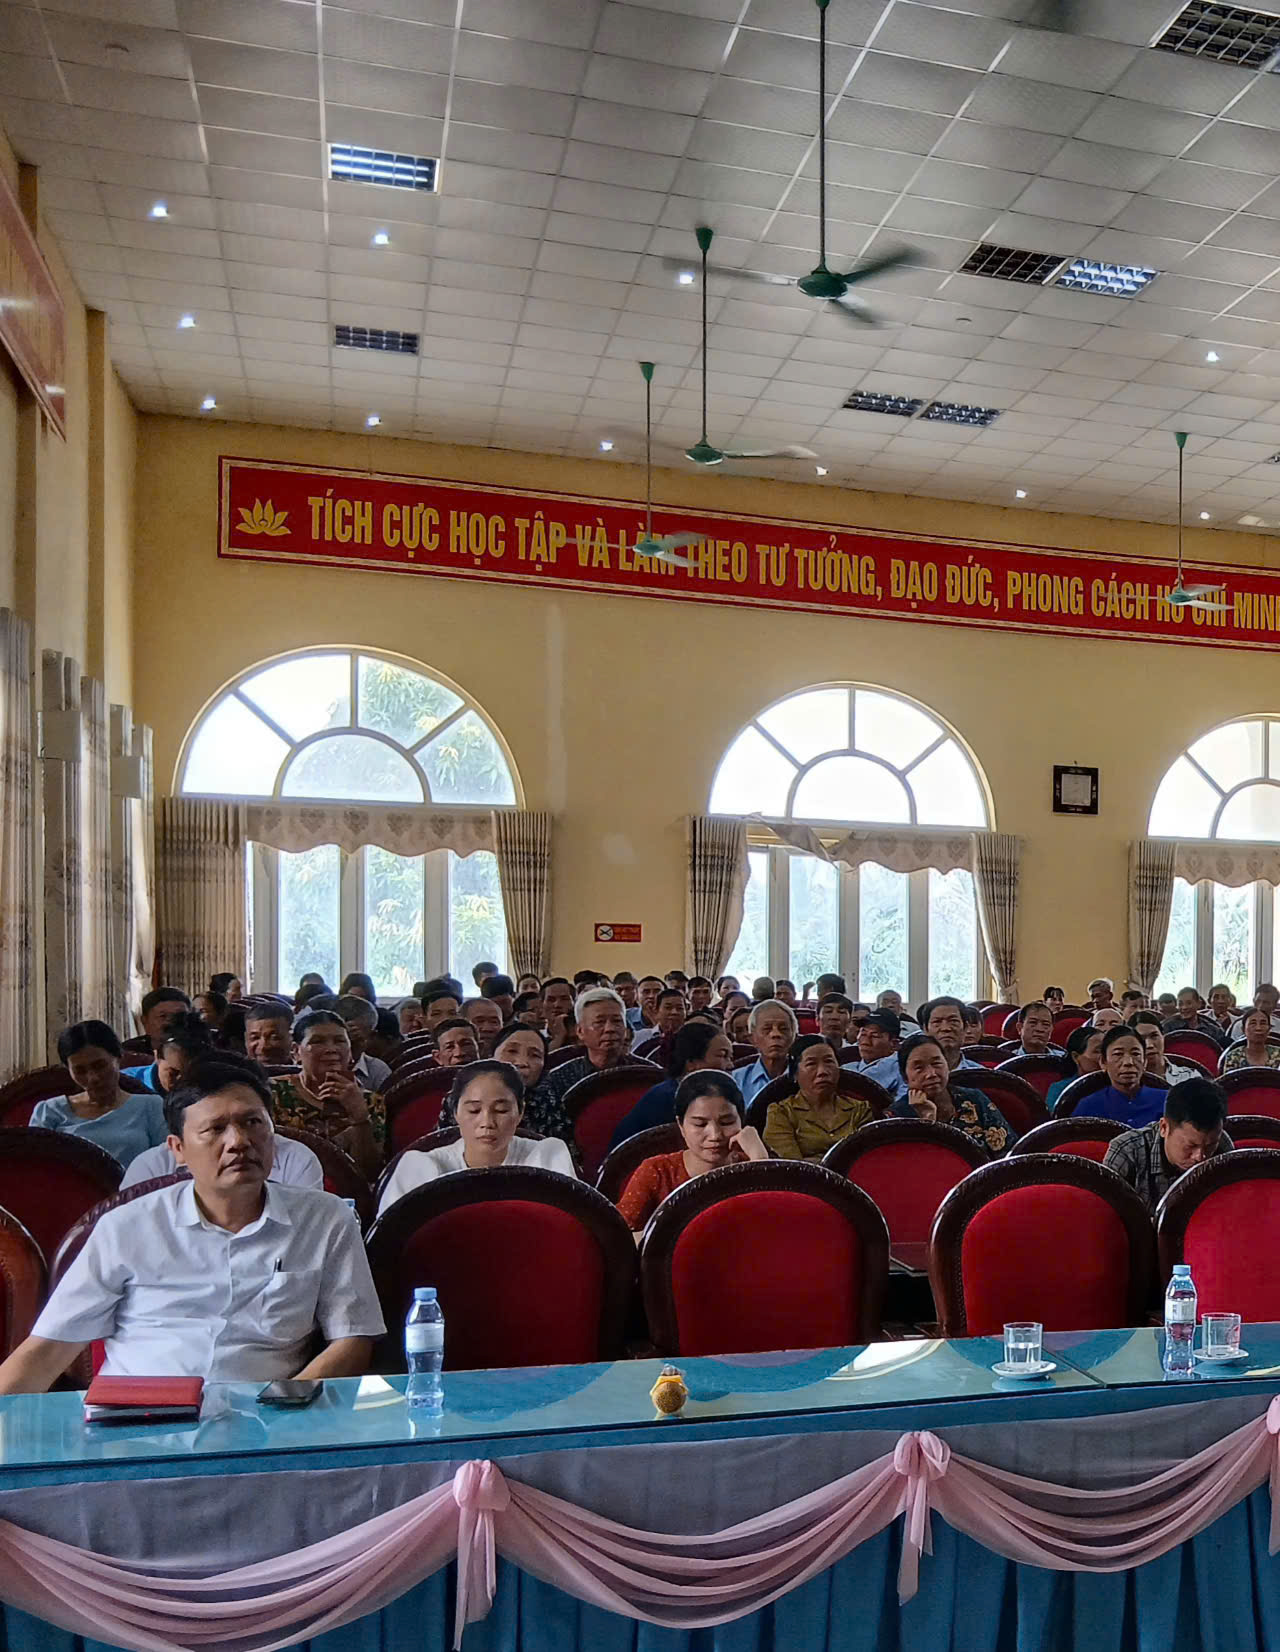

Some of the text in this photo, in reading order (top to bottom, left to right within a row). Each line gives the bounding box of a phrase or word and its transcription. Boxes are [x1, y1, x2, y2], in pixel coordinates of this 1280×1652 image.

[308, 489, 373, 545] TÍCH
[383, 502, 439, 558] CỰC
[449, 510, 506, 565] HỌC
[515, 512, 566, 571] TẬP
[575, 518, 610, 569] VÀ
[687, 536, 748, 583] THEO
[756, 543, 790, 586] TƯ
[794, 534, 882, 601] TƯỞNG,
[890, 559, 938, 609] ĐẠO
[946, 555, 999, 613] ĐỨC,
[1007, 571, 1084, 615] PHONG
[1091, 572, 1149, 621] CÁCH
